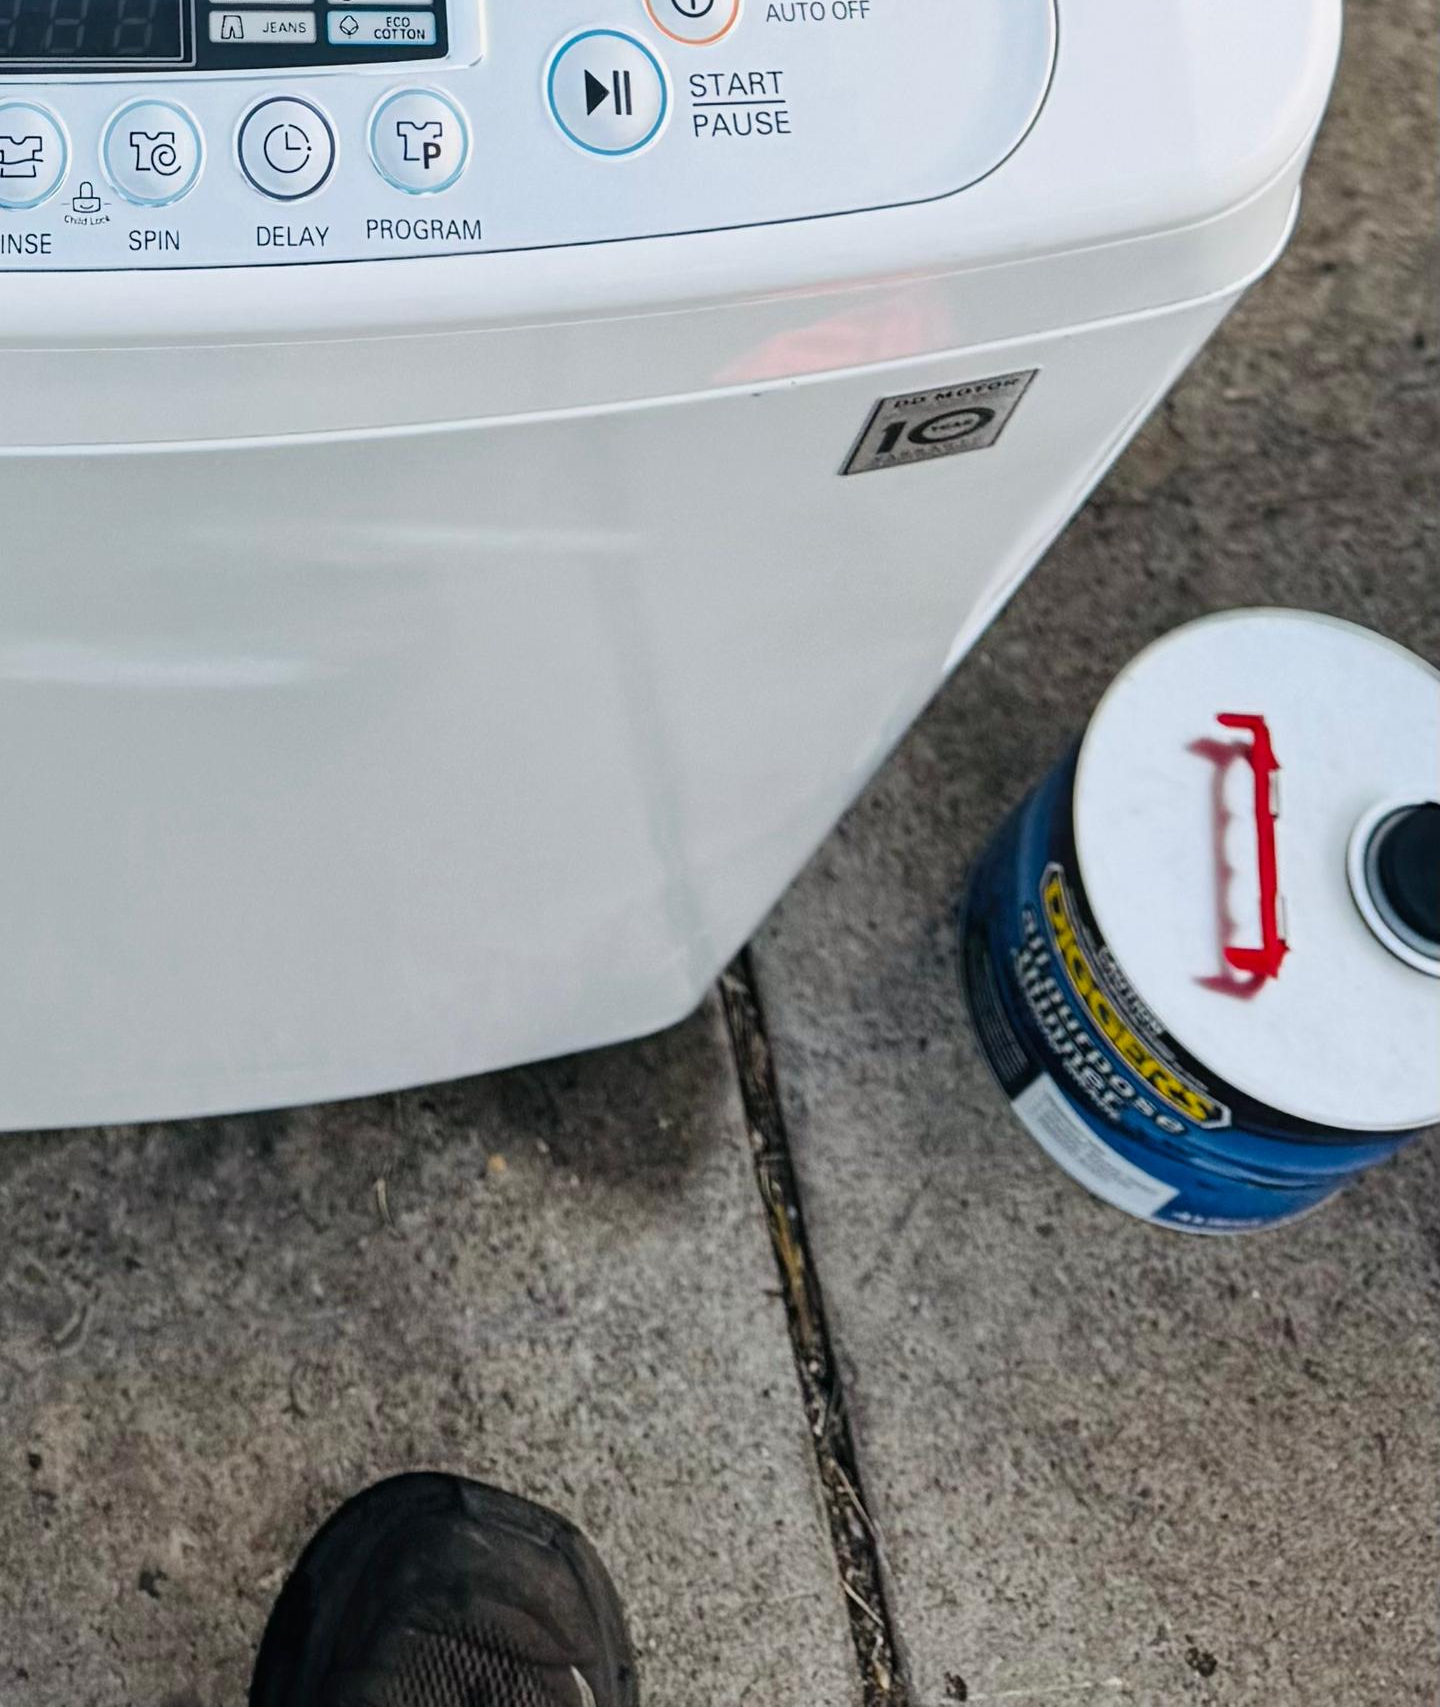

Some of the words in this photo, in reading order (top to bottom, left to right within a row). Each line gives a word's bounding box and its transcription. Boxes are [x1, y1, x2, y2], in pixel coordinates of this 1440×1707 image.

[386, 17, 411, 28] ECO
[765, 2, 826, 23] AUTO
[832, 1, 871, 20] OFF
[262, 21, 307, 34] JEANS
[374, 28, 426, 41] COTTON
[689, 71, 784, 98] START
[692, 111, 792, 138] PAUSE
[128, 230, 180, 251] SPIN
[256, 226, 329, 247] DELAY
[366, 219, 482, 241] PROGRAM
[1044, 878, 1208, 1121] DIGGERS
[1042, 977, 1185, 1133] purpose
